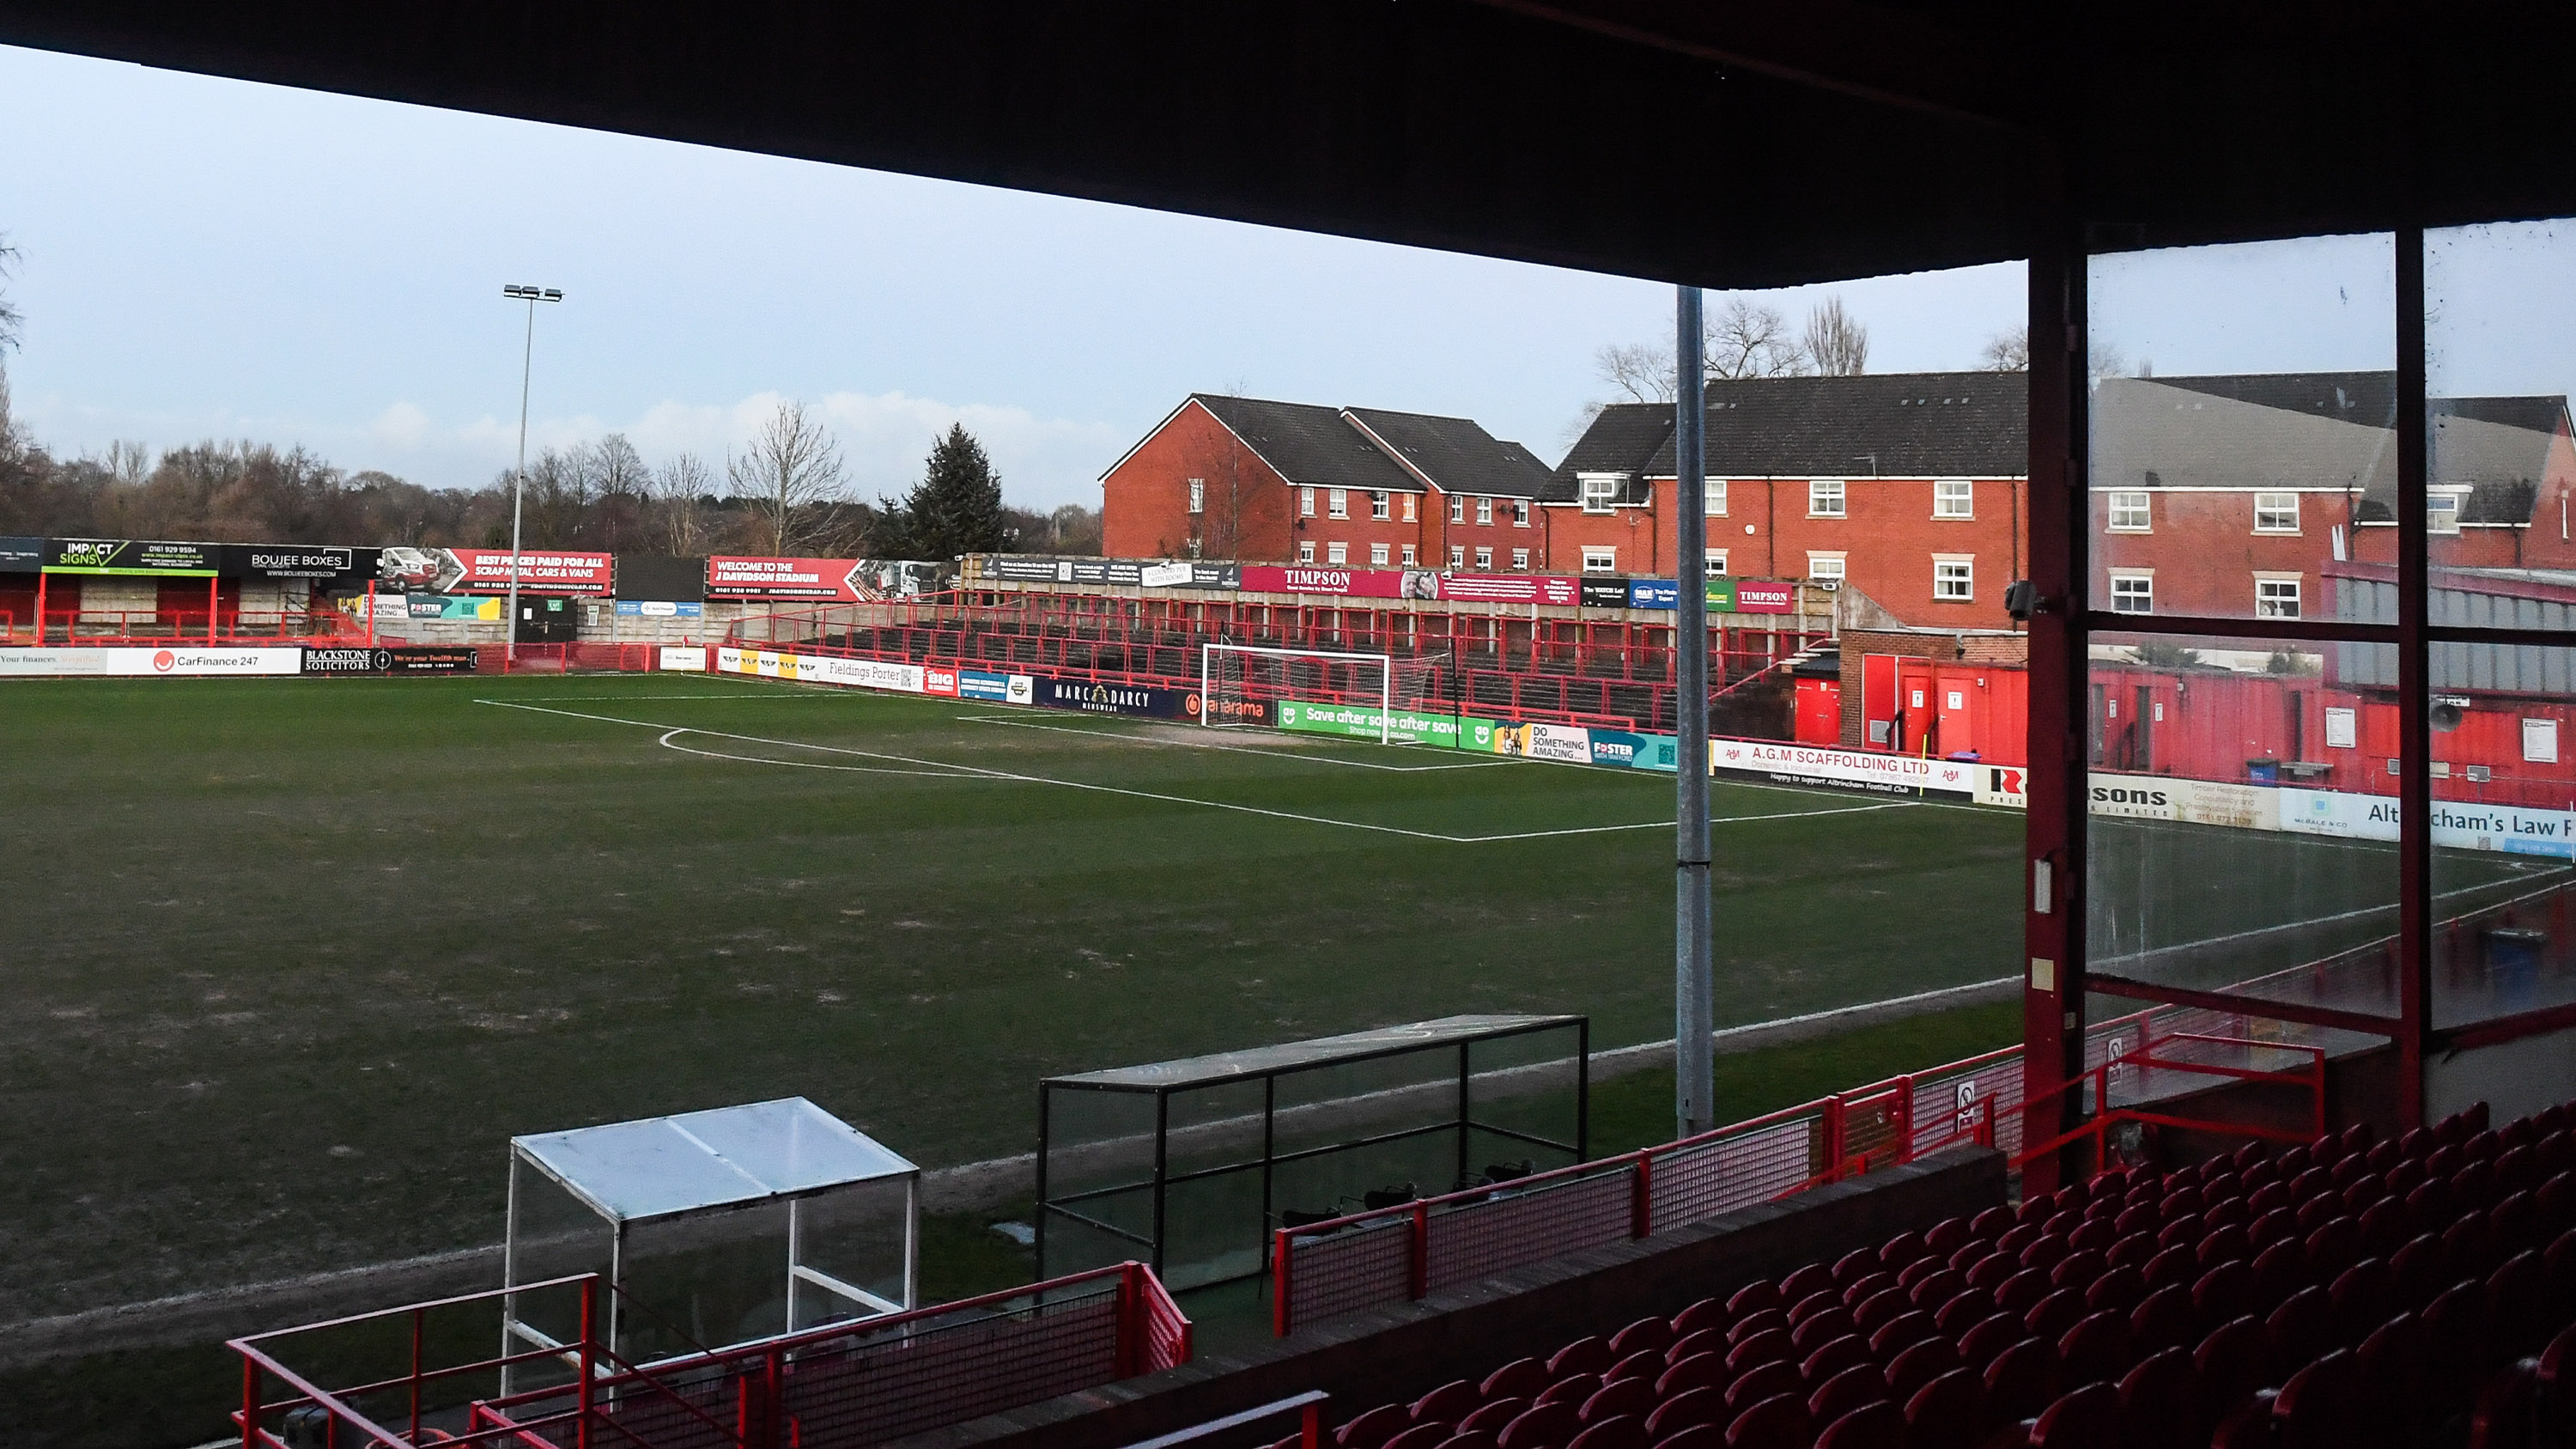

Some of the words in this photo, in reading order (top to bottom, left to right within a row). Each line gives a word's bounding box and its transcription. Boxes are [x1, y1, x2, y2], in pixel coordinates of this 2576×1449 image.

[68, 543, 113, 555] IMPACT
[60, 553, 96, 565] SIGNS
[252, 555, 299, 565] BOUJEE
[302, 556, 342, 566] BOXES
[475, 555, 500, 565] BEST
[500, 556, 536, 566] PRCES
[536, 557, 562, 567] PAID
[562, 557, 585, 567] FOR
[584, 557, 604, 568] ALL
[475, 566, 505, 575] SCRAP
[505, 567, 535, 578] MTAL,
[536, 568, 559, 577] CARS
[559, 568, 568, 577] &
[568, 568, 594, 578] VANS
[717, 562, 762, 572] WELCOME
[763, 563, 775, 572] TO
[776, 563, 793, 572] THE
[715, 571, 722, 581] J
[722, 572, 775, 582] DAVIDSON
[775, 573, 819, 583] STADIUM
[1285, 569, 1351, 587] TIMPSON
[1740, 591, 1788, 601] TIMPSON
[178, 656, 238, 666] CarFinance
[240, 656, 258, 666] 247
[307, 650, 370, 660] BLACKSTONE
[829, 661, 870, 680] Fieldings
[872, 667, 900, 681] Porter
[927, 673, 954, 685] BIG
[1055, 684, 1089, 701] MARC
[1111, 689, 1149, 707] DARCY
[1082, 702, 1117, 712] MENSWEAR
[1306, 707, 1335, 722] Save
[1336, 709, 1366, 725] after
[1368, 715, 1397, 728] sae
[1399, 716, 1431, 732] after
[1431, 721, 1461, 734] save
[1349, 725, 1365, 735] Shop
[1533, 727, 1547, 737] DO
[1533, 737, 1584, 751] SOMETHING
[1594, 742, 1633, 756] FOSTER
[1753, 746, 1792, 761] A.G.M
[1796, 750, 1898, 772] SCAFFOLDING
[1903, 761, 1929, 775] LTD
[1770, 773, 1791, 783] Happy
[1801, 776, 1826, 785] support
[1827, 778, 1865, 789] Altrincham
[1866, 782, 1893, 792] Football
[1893, 785, 1909, 794] Club
[2087, 787, 2167, 806] sons
[2106, 806, 2167, 817] LIMITED
[2513, 815, 2555, 837] Law
